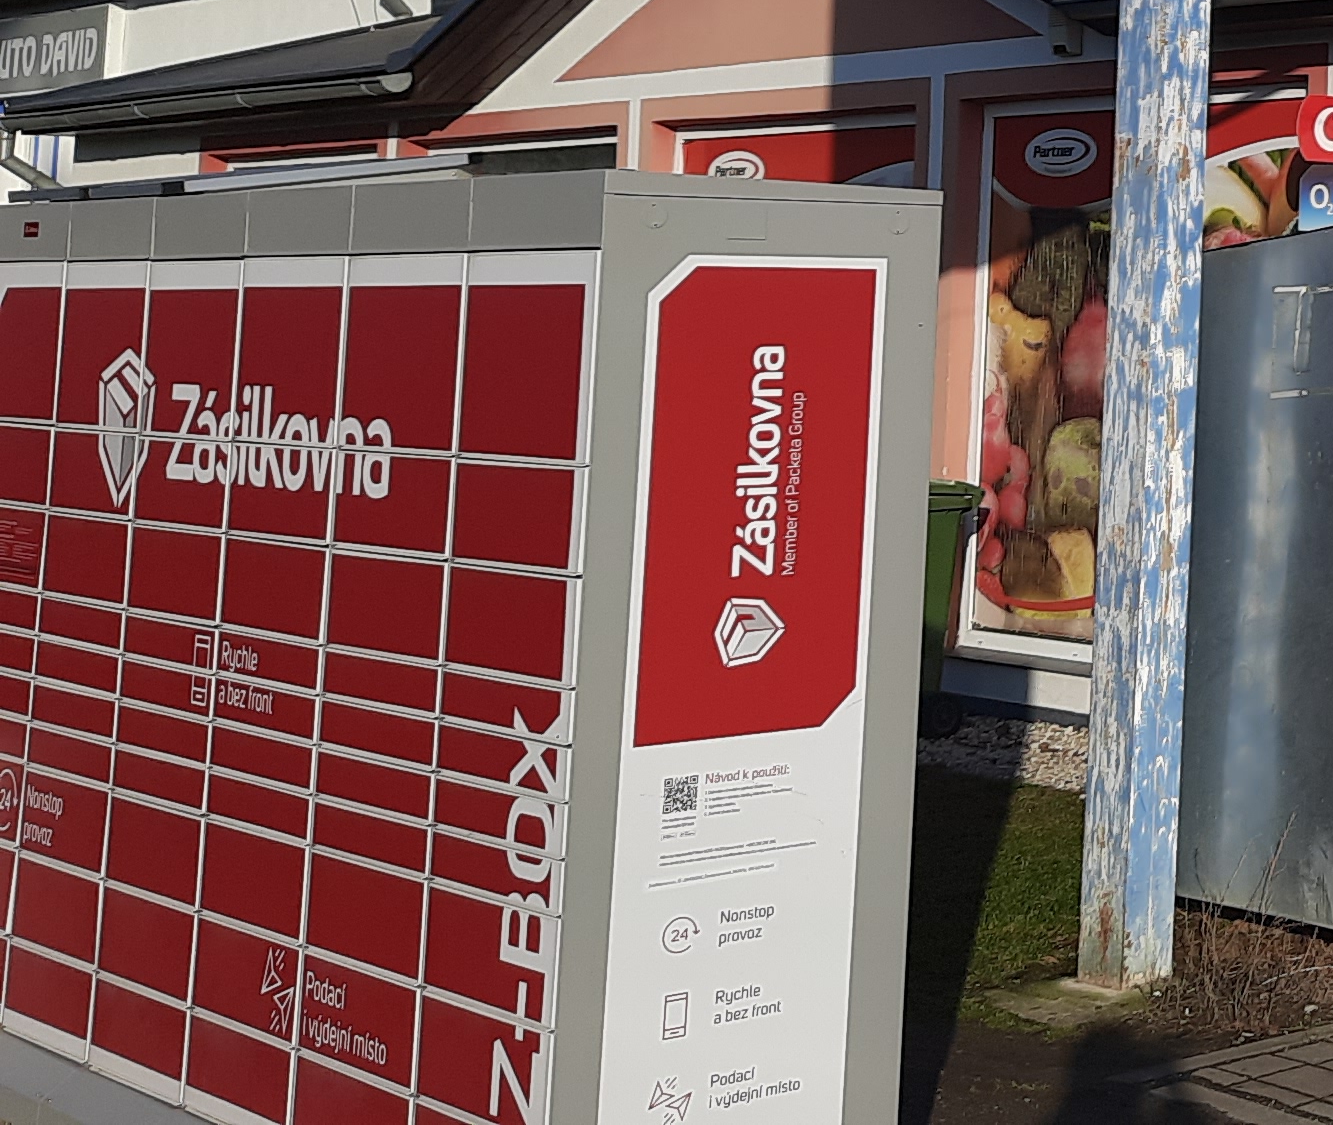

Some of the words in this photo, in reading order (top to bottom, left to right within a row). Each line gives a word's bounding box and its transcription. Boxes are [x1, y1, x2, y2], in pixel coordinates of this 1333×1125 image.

[0, 35, 37, 79] UTO
[40, 27, 98, 78] DAVID
[1032, 145, 1076, 158] Partner
[788, 392, 808, 436] Group
[165, 383, 392, 500] Zásilkovna
[731, 344, 786, 578] Zásilkovna
[785, 439, 803, 496] Packeta
[785, 498, 798, 512] of
[781, 516, 798, 577] Member
[221, 641, 258, 672] Rychle
[218, 684, 226, 704] a
[227, 679, 246, 708] bez
[248, 685, 274, 715] front
[705, 768, 741, 785] Návod
[742, 768, 750, 780] k
[26, 783, 64, 821] Nonstop
[23, 821, 53, 847] provoz
[488, 706, 561, 1125] Z-BOX
[720, 905, 775, 925] Nonstop
[670, 928, 689, 943] 24
[718, 927, 763, 948] provoz
[305, 970, 348, 1011] Podací
[714, 984, 761, 1005] Rychle
[713, 1013, 722, 1025] a
[725, 1006, 749, 1023] bez
[751, 1000, 782, 1018] front
[302, 1009, 308, 1036] i
[308, 1014, 353, 1054] výdejní
[352, 1032, 387, 1065] místo
[709, 1066, 756, 1088] Podací
[708, 1094, 713, 1109] i
[715, 1084, 763, 1109] výdejní
[765, 1079, 801, 1097] místo
